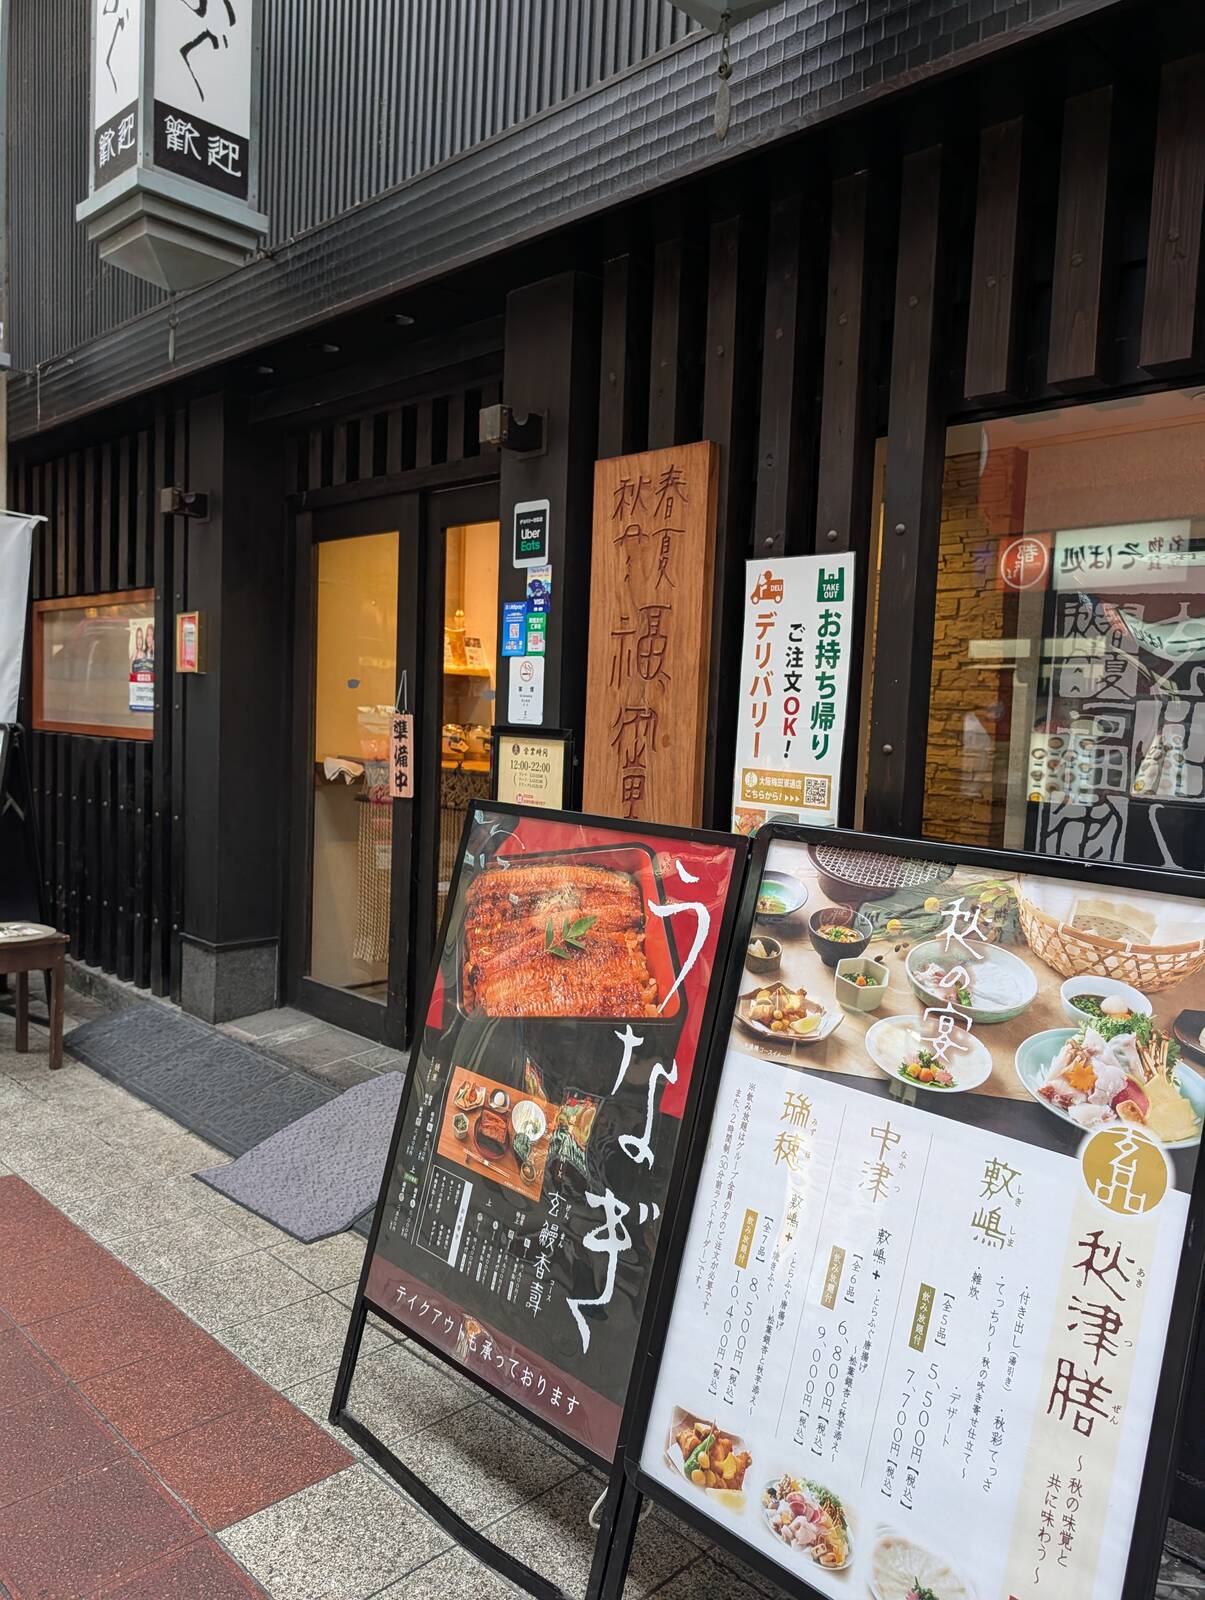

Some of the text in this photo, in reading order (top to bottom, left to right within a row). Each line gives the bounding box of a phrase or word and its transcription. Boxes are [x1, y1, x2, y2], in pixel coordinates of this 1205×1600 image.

[520, 528, 541, 540] Uber
[520, 540, 541, 552] Eats
[770, 584, 783, 592] DELI
[822, 583, 840, 591] TAKE
[823, 591, 839, 599] OUT
[750, 611, 778, 757] デリバリー
[810, 609, 842, 760] お持ち帰り
[393, 719, 409, 793] 準備中
[921, 896, 994, 1063] 秋の宴
[566, 859, 711, 1355] うなぎ
[858, 1120, 901, 1203] 中津
[898, 1151, 909, 1170] なか
[1014, 1184, 1025, 1208] しき
[1006, 1225, 1017, 1248] しま
[1136, 1267, 1146, 1289] あき
[1047, 1229, 1136, 1437] 秋津膳
[1124, 1339, 1134, 1348] つ
[396, 1285, 580, 1415] テイクアウトも承っております
[1109, 1403, 1123, 1426] ぜん
